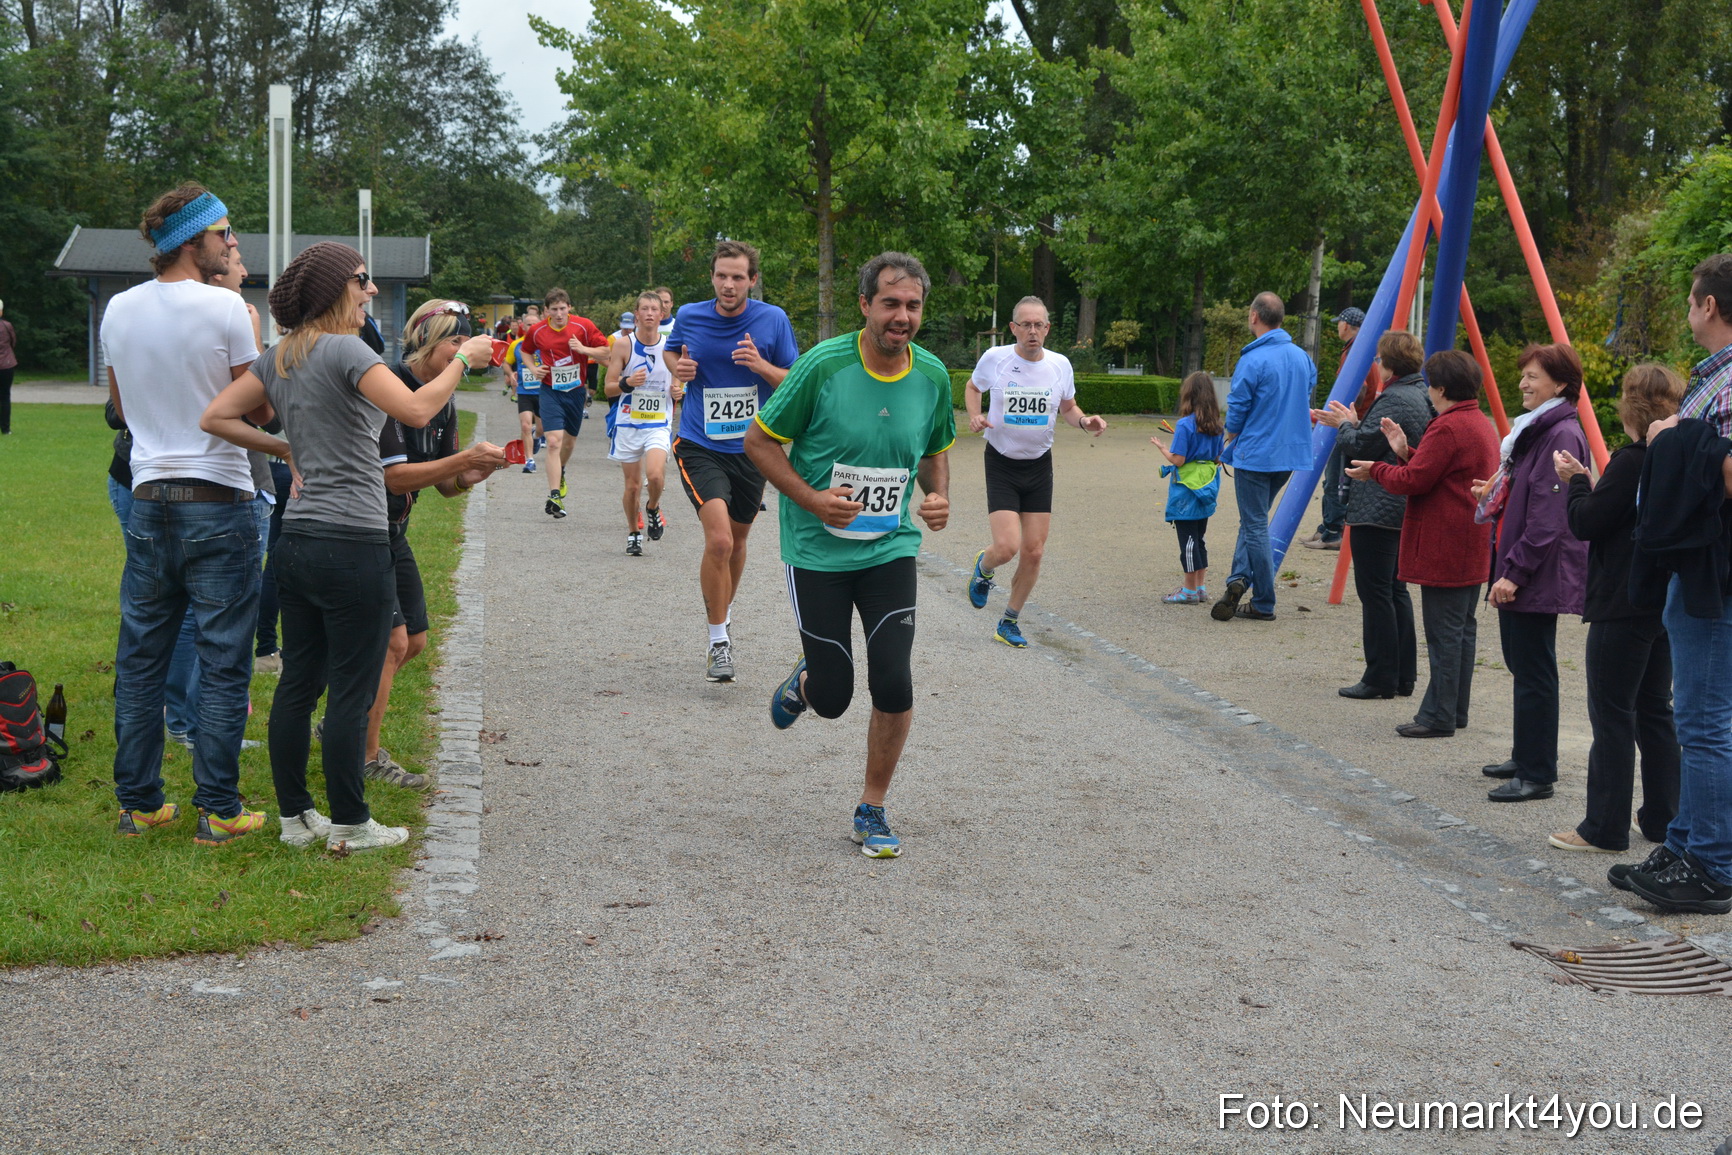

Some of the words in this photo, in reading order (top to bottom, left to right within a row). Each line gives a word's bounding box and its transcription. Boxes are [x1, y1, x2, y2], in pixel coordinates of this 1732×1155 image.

[555, 371, 578, 383] 2674
[638, 398, 660, 411] 209
[710, 399, 755, 420] 2425
[1008, 397, 1047, 413] 2946
[1015, 416, 1038, 424] Markus
[721, 424, 746, 432] Fabian
[833, 471, 862, 482] PARTL
[863, 474, 898, 483] Neumarkt
